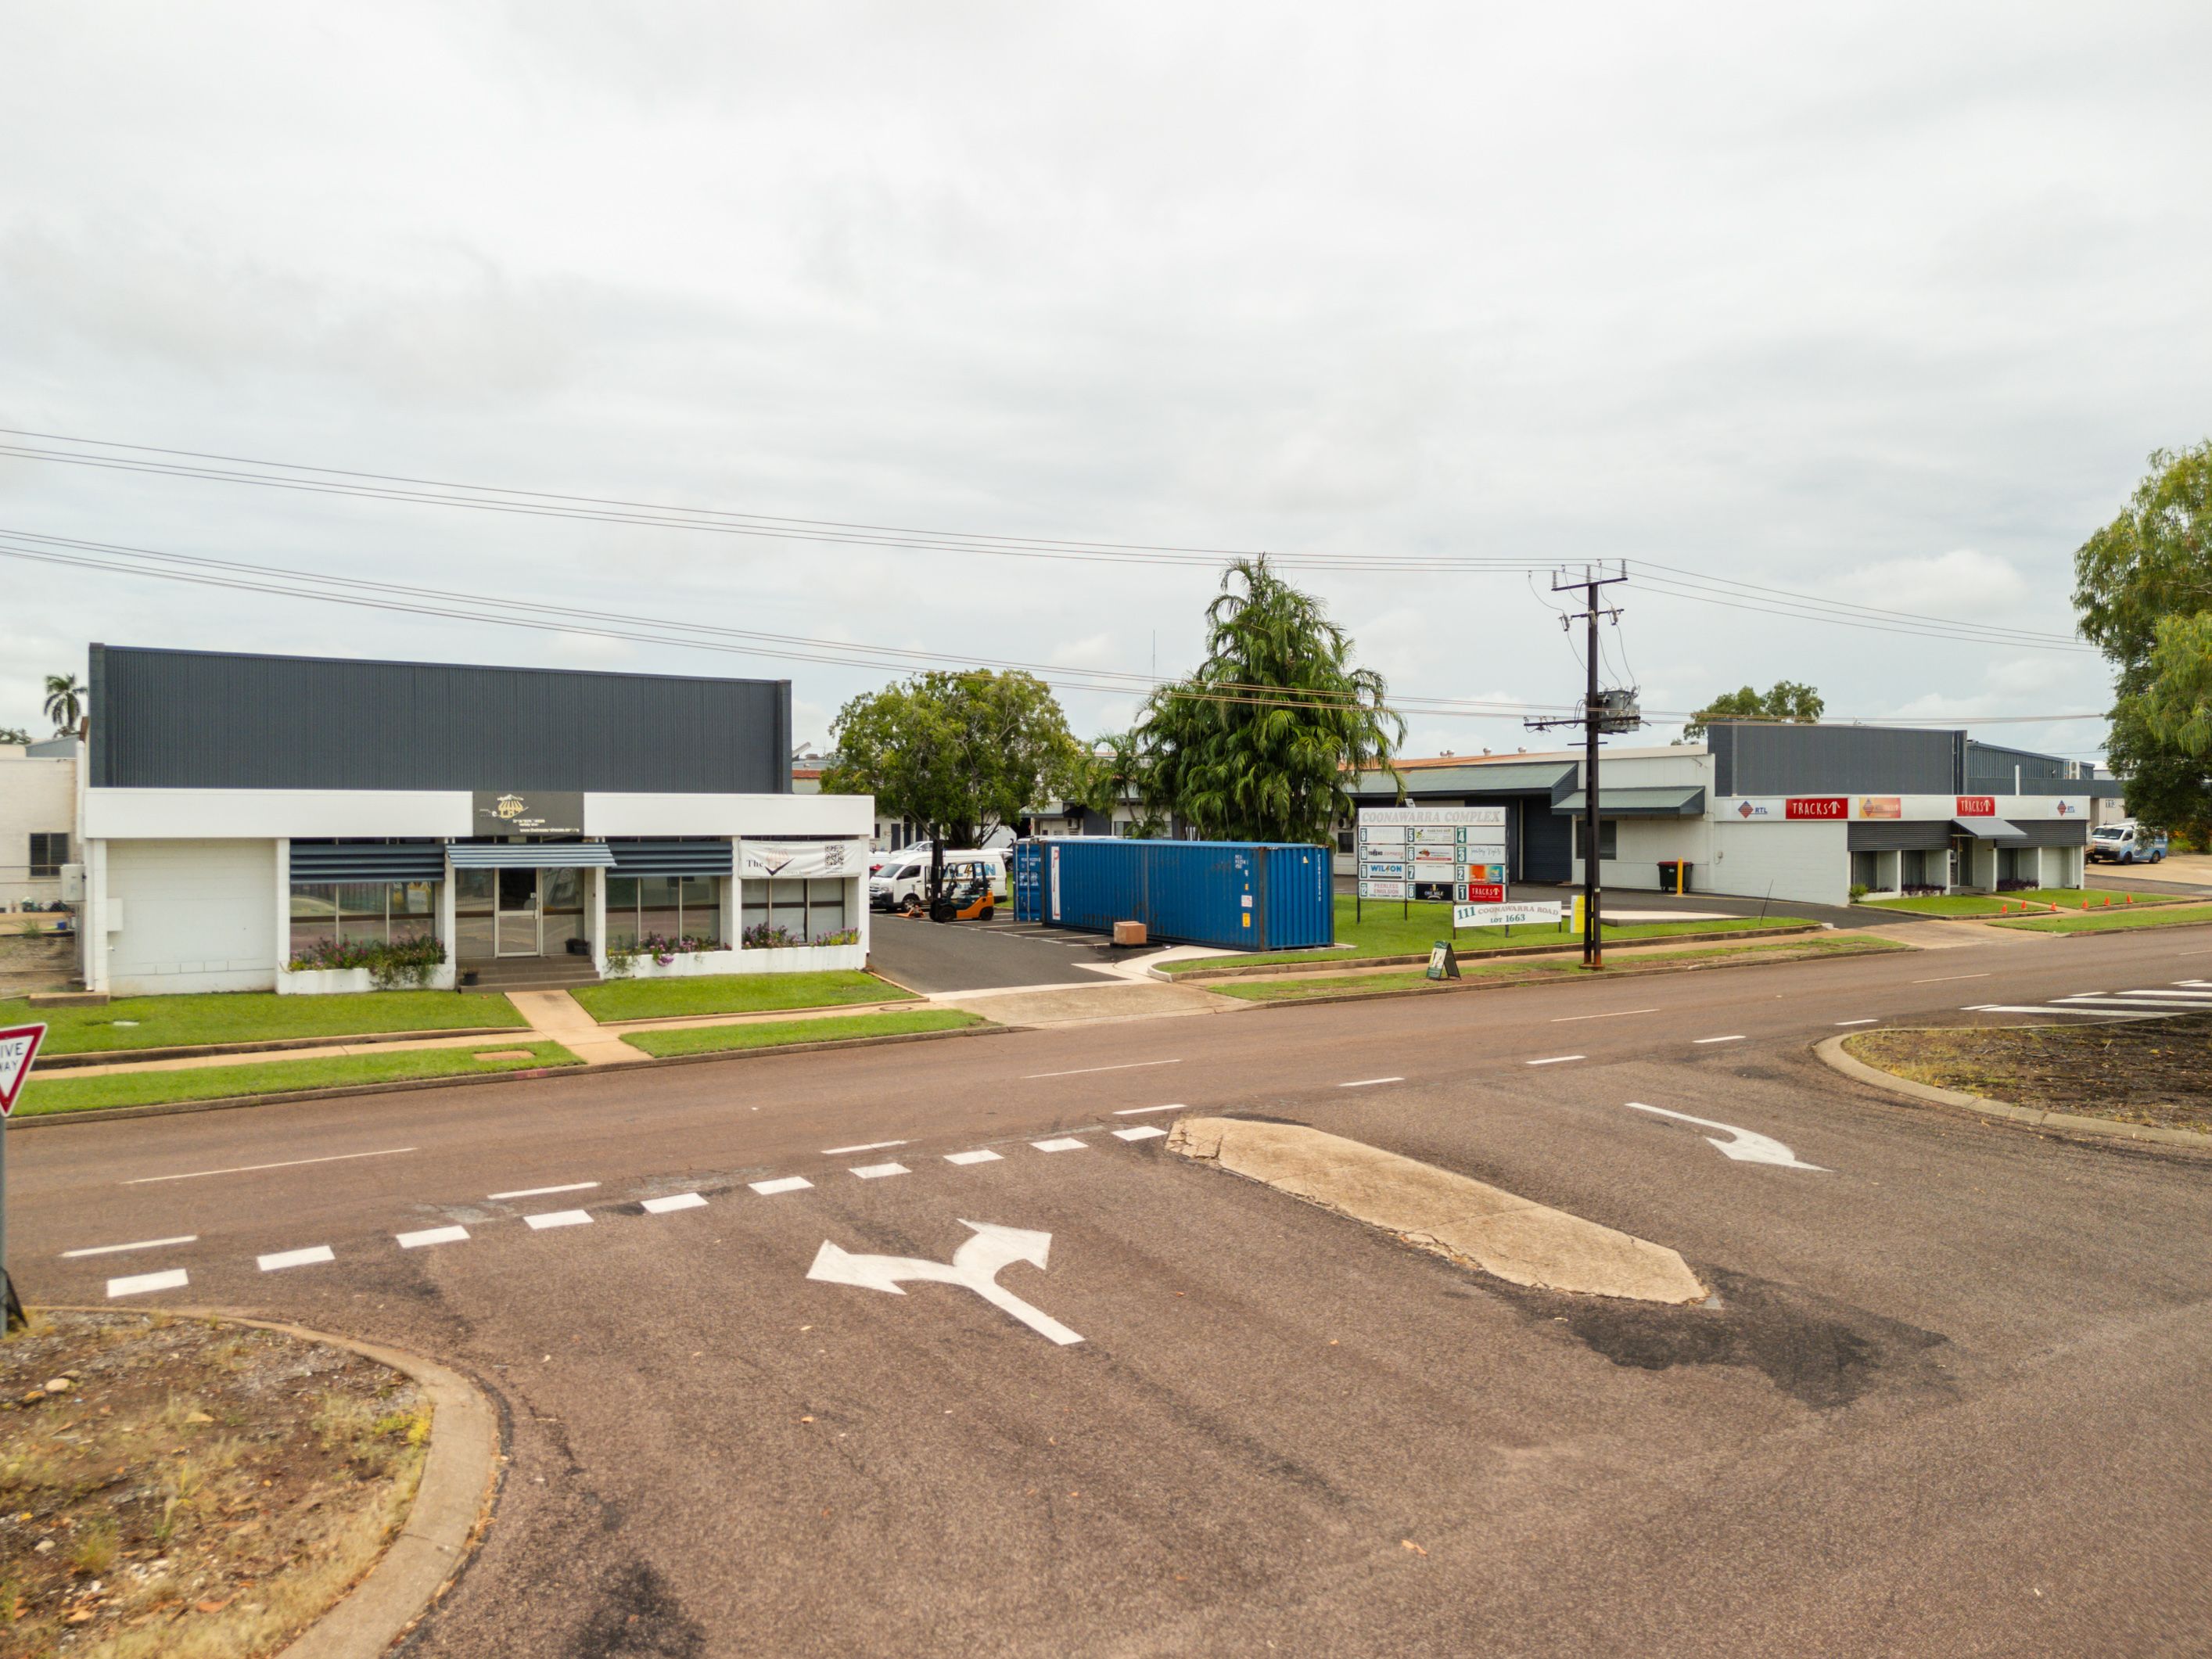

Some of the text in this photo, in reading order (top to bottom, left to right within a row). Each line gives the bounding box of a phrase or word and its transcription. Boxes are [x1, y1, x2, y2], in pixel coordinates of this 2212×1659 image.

[1792, 803, 1828, 815] TRACKS
[1961, 799, 1984, 812] TRACKS
[1362, 810, 1500, 823] COONAWARRA COMPLEX
[1408, 831, 1413, 842] 5
[1458, 831, 1465, 842] 4
[1408, 849, 1414, 860] 6
[1458, 850, 1465, 861] 3
[746, 859, 763, 867] The
[1408, 868, 1414, 879] 7
[1458, 870, 1463, 880] 2
[1408, 887, 1413, 898] 8
[1458, 905, 1559, 920] 111 COONAWARRA ROAD
[1506, 914, 1525, 922] 1663
[0, 1043, 23, 1058] IVE
[0, 1060, 18, 1072] AY
